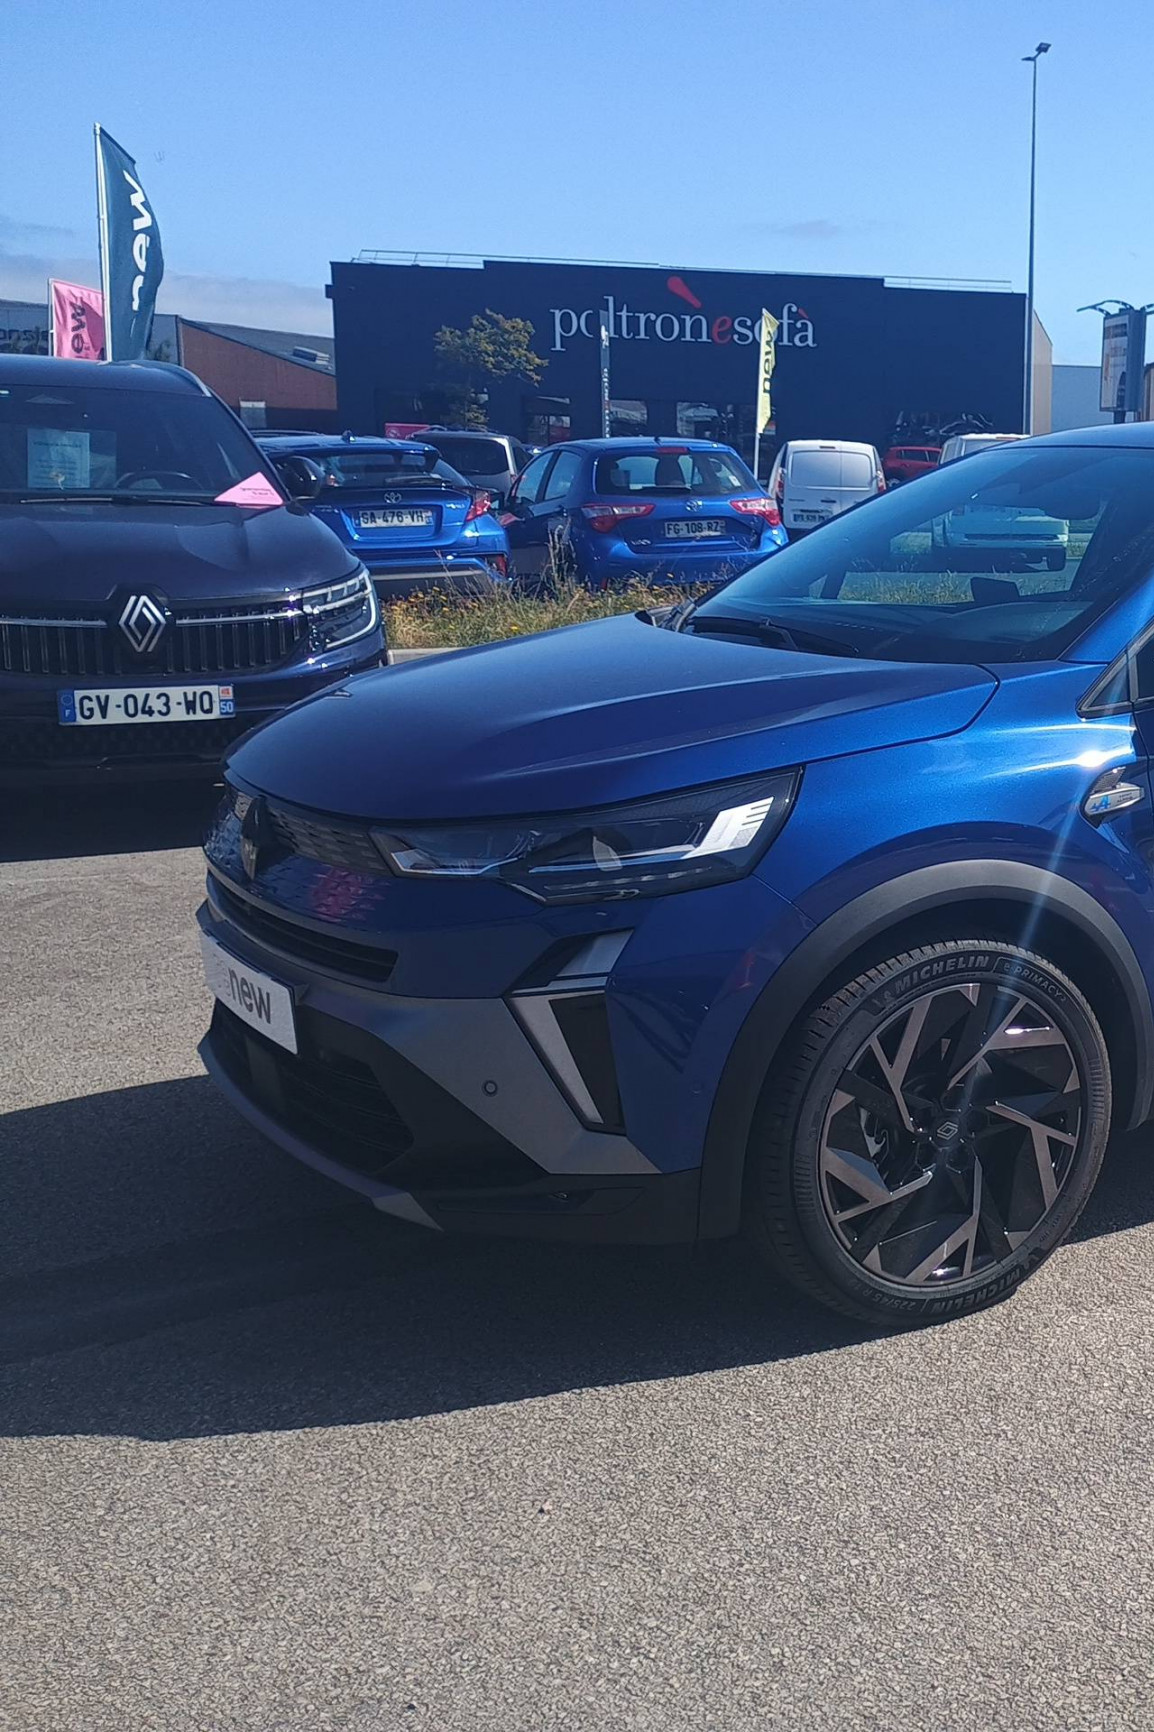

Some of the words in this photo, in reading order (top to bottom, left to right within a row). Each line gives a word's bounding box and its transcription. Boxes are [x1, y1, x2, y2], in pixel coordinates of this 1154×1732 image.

[78, 690, 214, 720] GV-043-WQ
[220, 701, 233, 713] 50
[894, 955, 990, 994] MICHELIN
